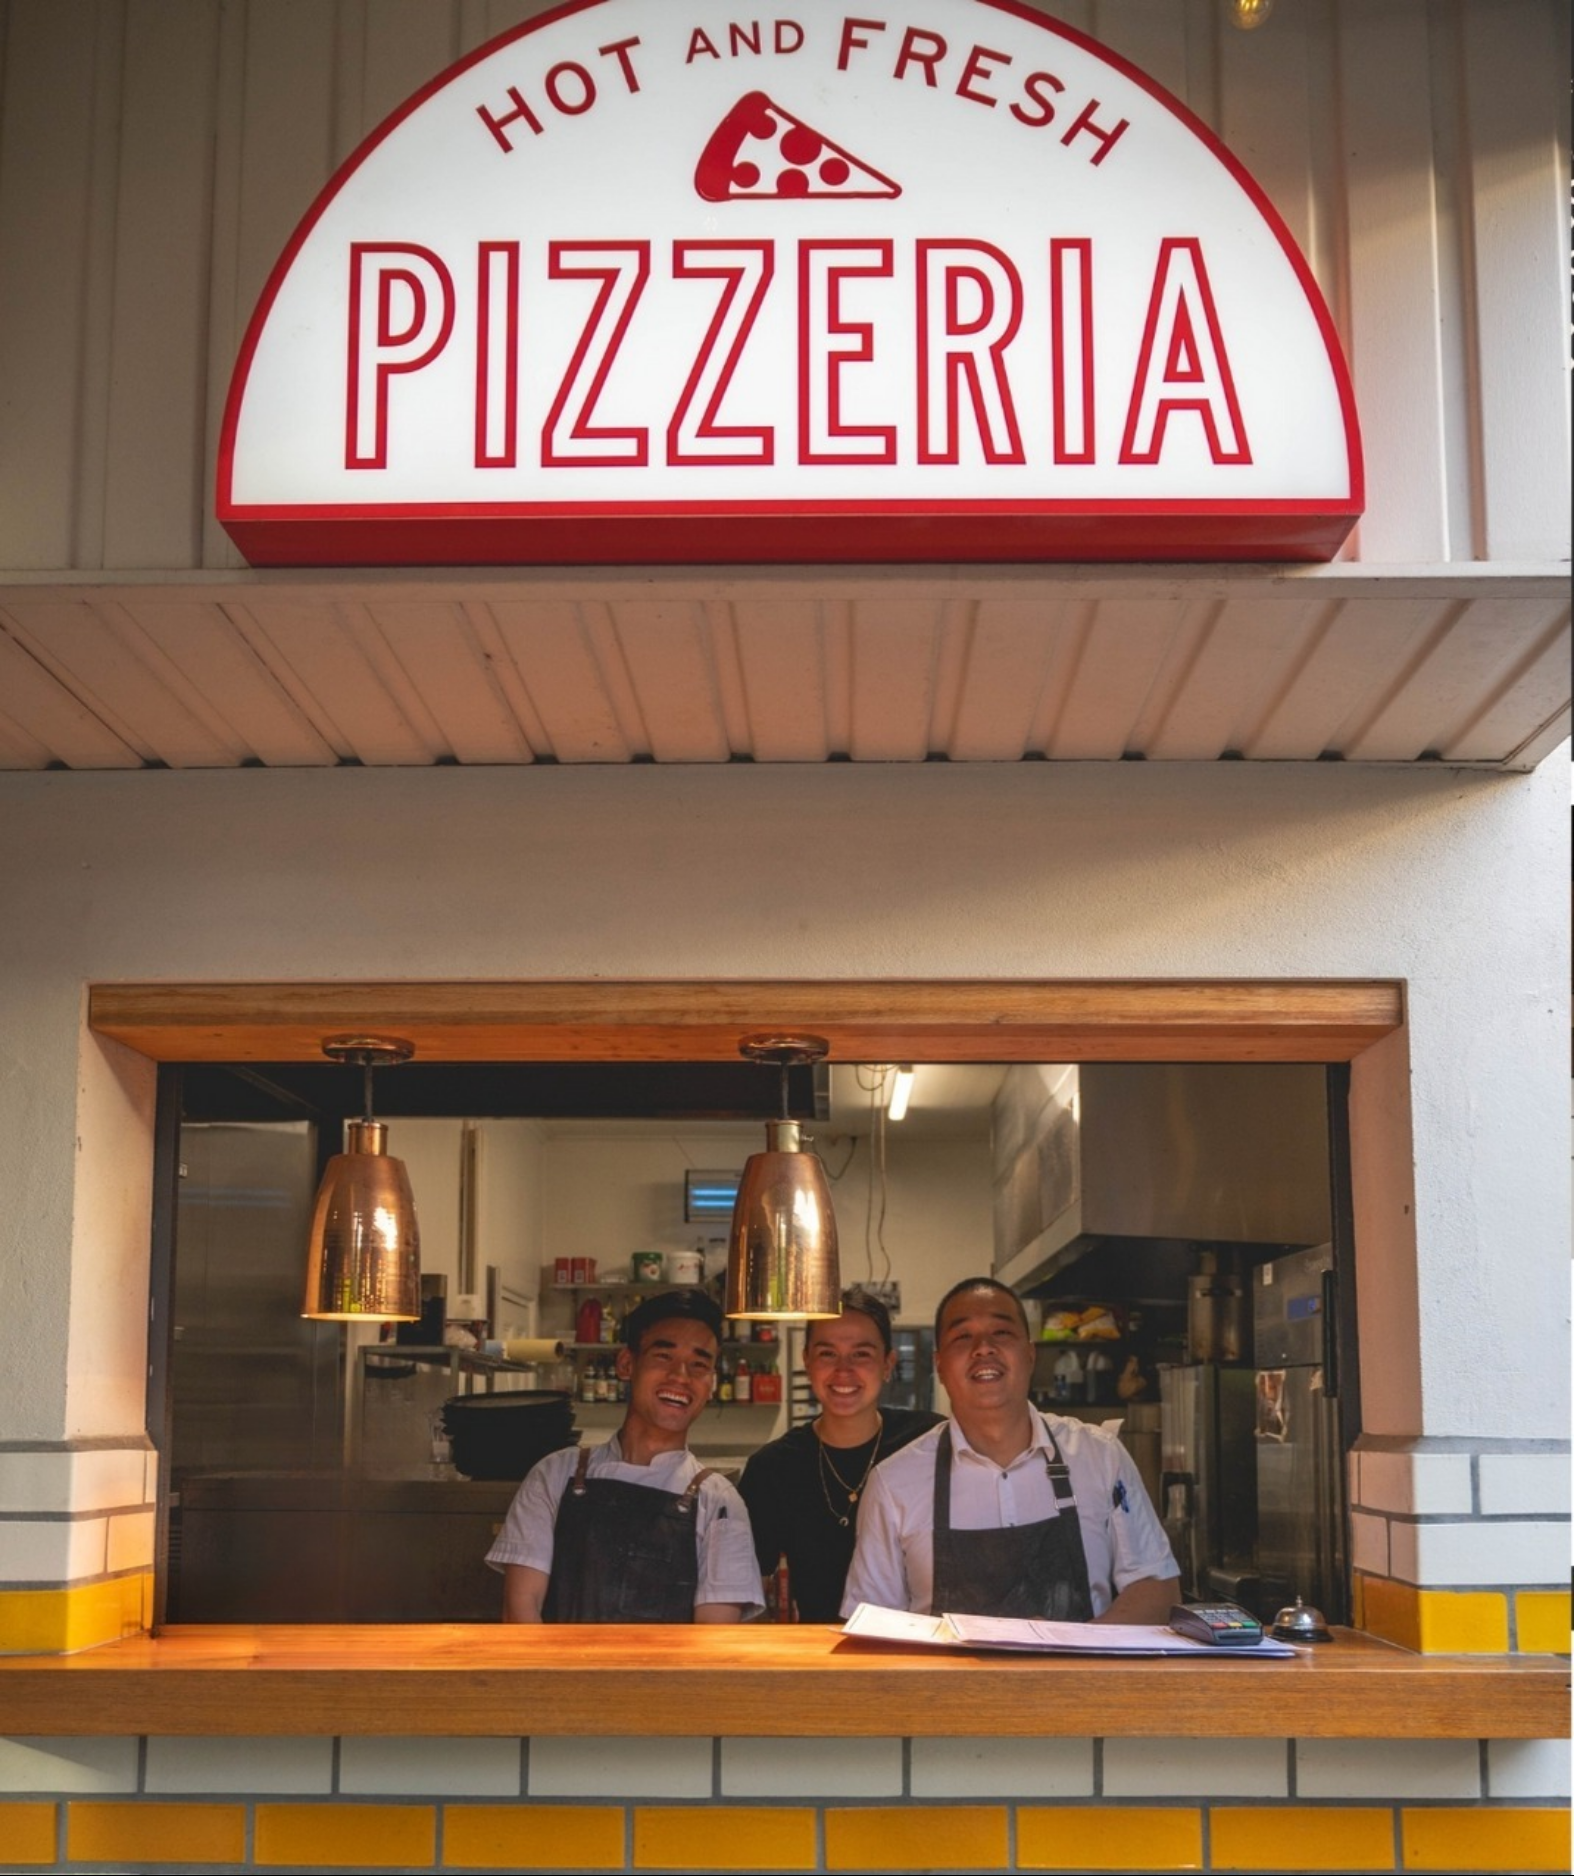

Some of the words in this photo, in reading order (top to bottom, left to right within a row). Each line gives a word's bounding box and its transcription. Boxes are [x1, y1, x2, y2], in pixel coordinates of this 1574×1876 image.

[478, 39, 641, 153] HOT
[687, 21, 804, 62] AND
[838, 20, 1128, 164] FRESH
[345, 237, 1252, 470] PIZZERIA
